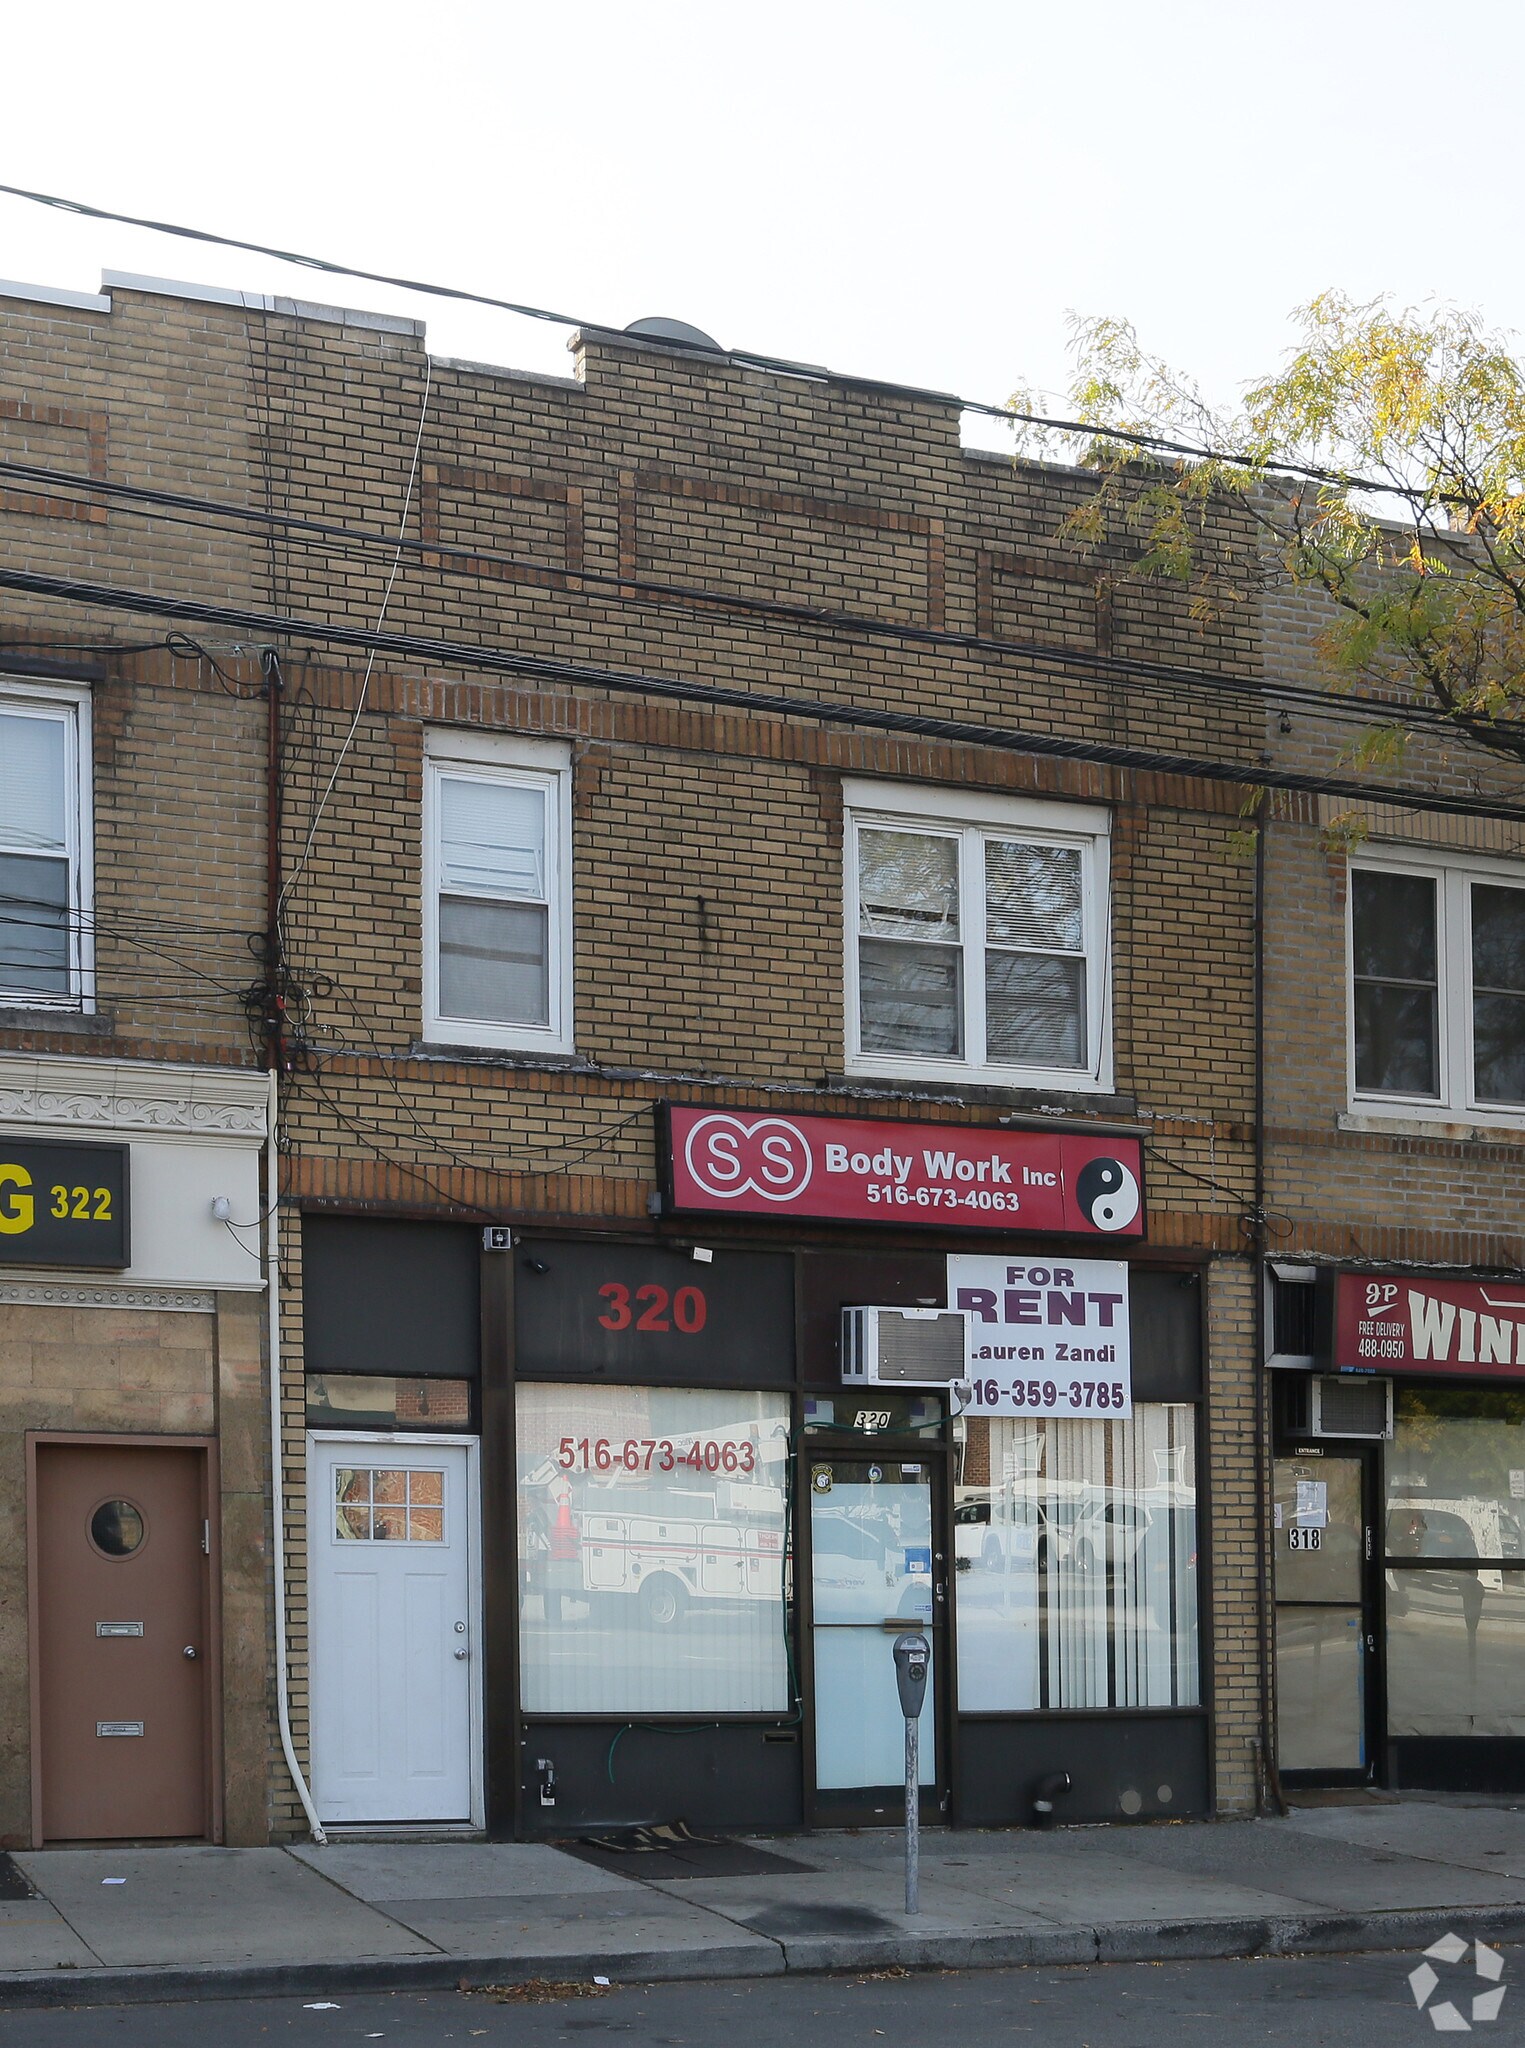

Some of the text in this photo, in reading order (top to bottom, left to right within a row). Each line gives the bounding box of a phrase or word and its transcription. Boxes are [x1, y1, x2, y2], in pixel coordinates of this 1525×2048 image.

[825, 1143, 1057, 1187] Body Work Inc
[50, 1185, 112, 1221] 322
[866, 1183, 1020, 1212] 516-673-4063
[1006, 1266, 1075, 1287] FOR
[1365, 1282, 1398, 1305] JP
[597, 1282, 707, 1334] 320
[957, 1288, 1123, 1327] RENT
[1358, 1320, 1405, 1338] FREE DELIVERY
[971, 1343, 1116, 1363] auren Zandi
[1358, 1338, 1405, 1359] 488-0950
[969, 1379, 1124, 1409] 16-359-3785
[856, 1411, 888, 1428] 320
[558, 1437, 755, 1472] 516-673-4063
[1290, 1528, 1320, 1549] 318
